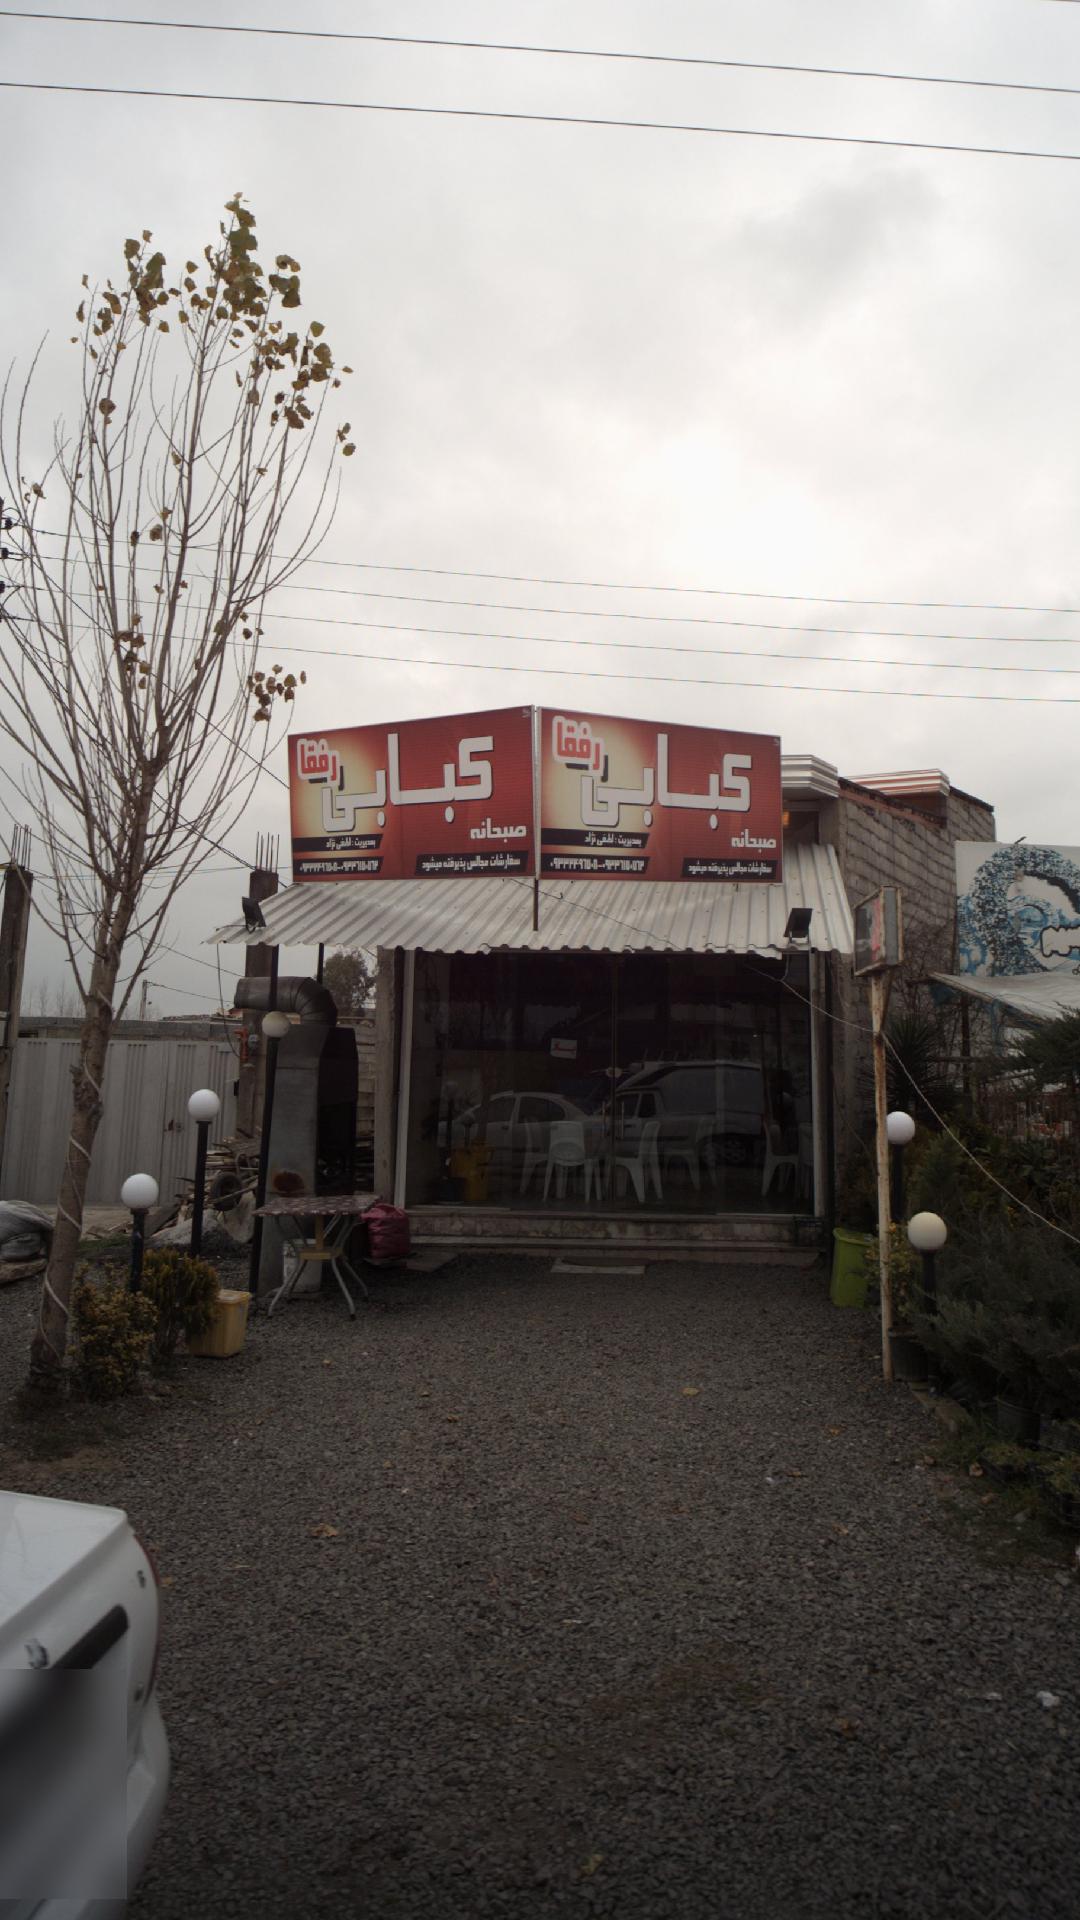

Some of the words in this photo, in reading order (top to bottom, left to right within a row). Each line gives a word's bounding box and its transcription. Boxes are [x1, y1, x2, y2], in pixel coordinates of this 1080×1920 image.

[553, 717, 604, 776] رفقا
[298, 739, 339, 783] رفقا
[322, 733, 494, 832] کبابی
[581, 734, 752, 830] کبابی
[470, 818, 527, 843] صبحانه
[731, 828, 777, 853] صبحانه
[443, 857, 466, 872] پذیرفته
[467, 855, 489, 870] مجالس
[490, 853, 521, 869] سفارشات
[708, 862, 728, 877] پذیرفته
[729, 861, 748, 875] مجالس
[748, 861, 773, 875] سفارشات
